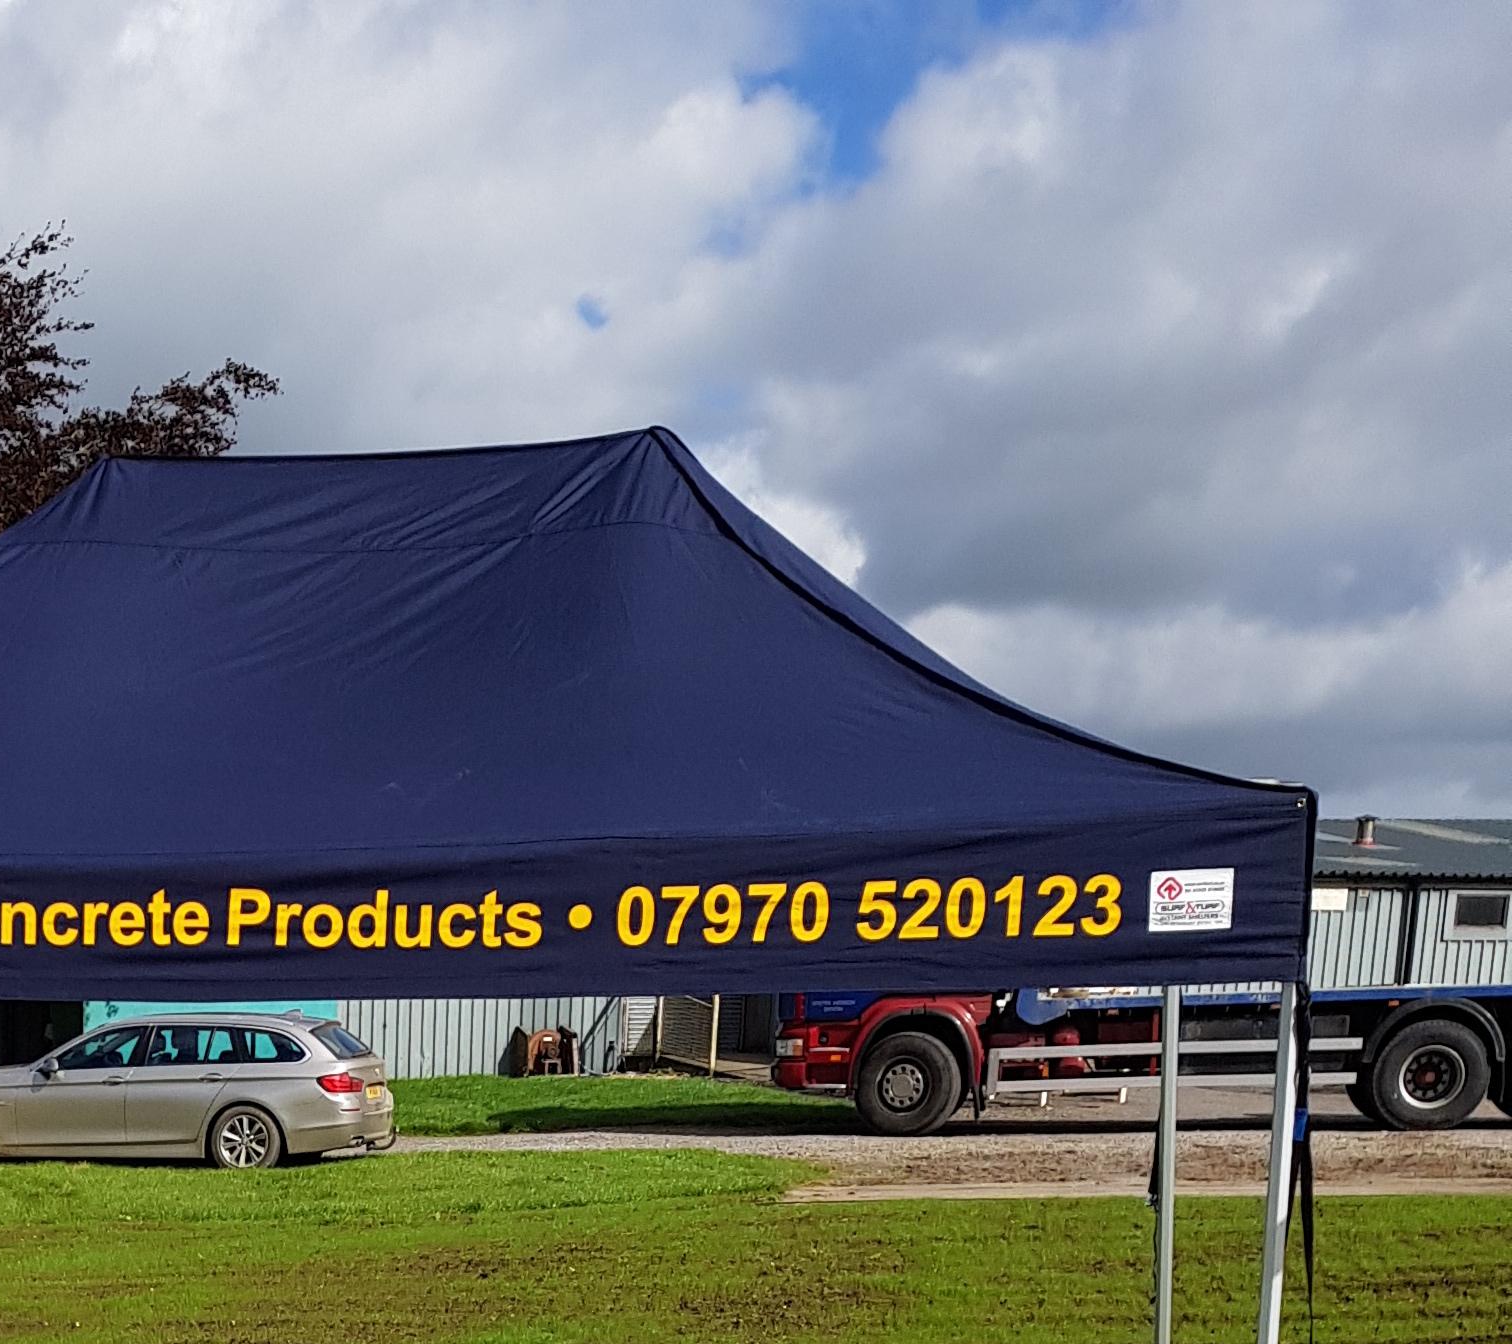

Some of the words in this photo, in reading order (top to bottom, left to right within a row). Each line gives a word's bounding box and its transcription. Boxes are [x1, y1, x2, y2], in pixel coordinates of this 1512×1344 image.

[226, 887, 544, 950] Products
[616, 881, 831, 948] 07970
[854, 873, 1123, 942] 520123
